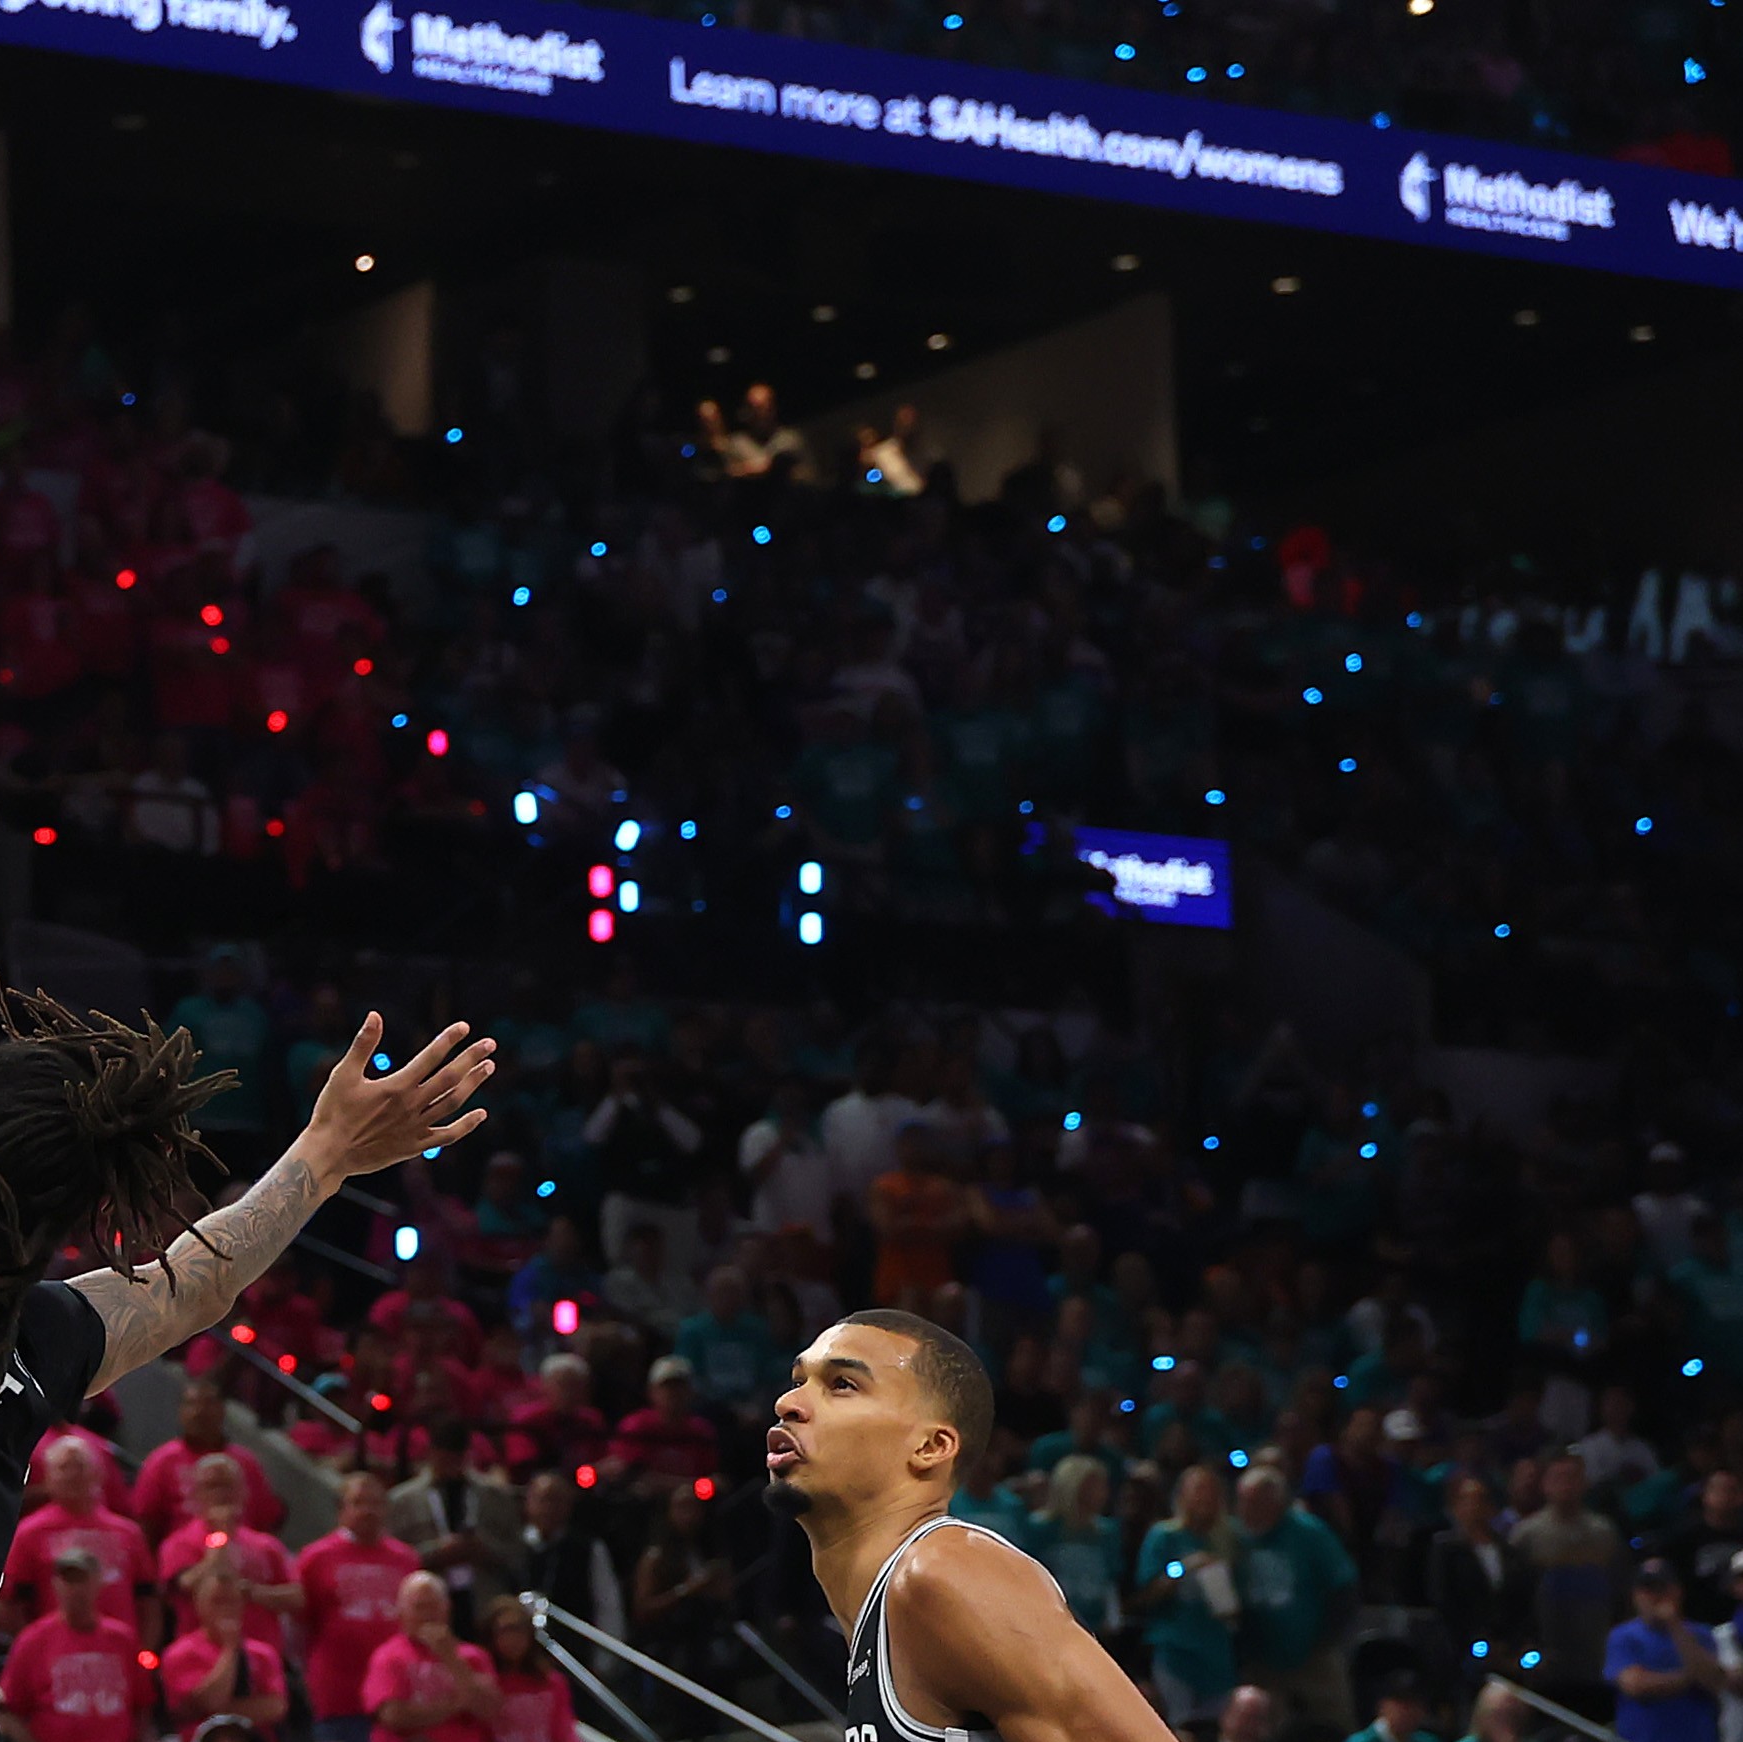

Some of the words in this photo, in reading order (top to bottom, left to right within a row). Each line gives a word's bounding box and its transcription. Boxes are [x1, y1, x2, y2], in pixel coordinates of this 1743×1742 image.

[411, 12, 605, 82] Methodist
[670, 56, 777, 116] Learn
[779, 82, 881, 131] more
[882, 94, 926, 137] at
[1442, 162, 1616, 229] Methodist
